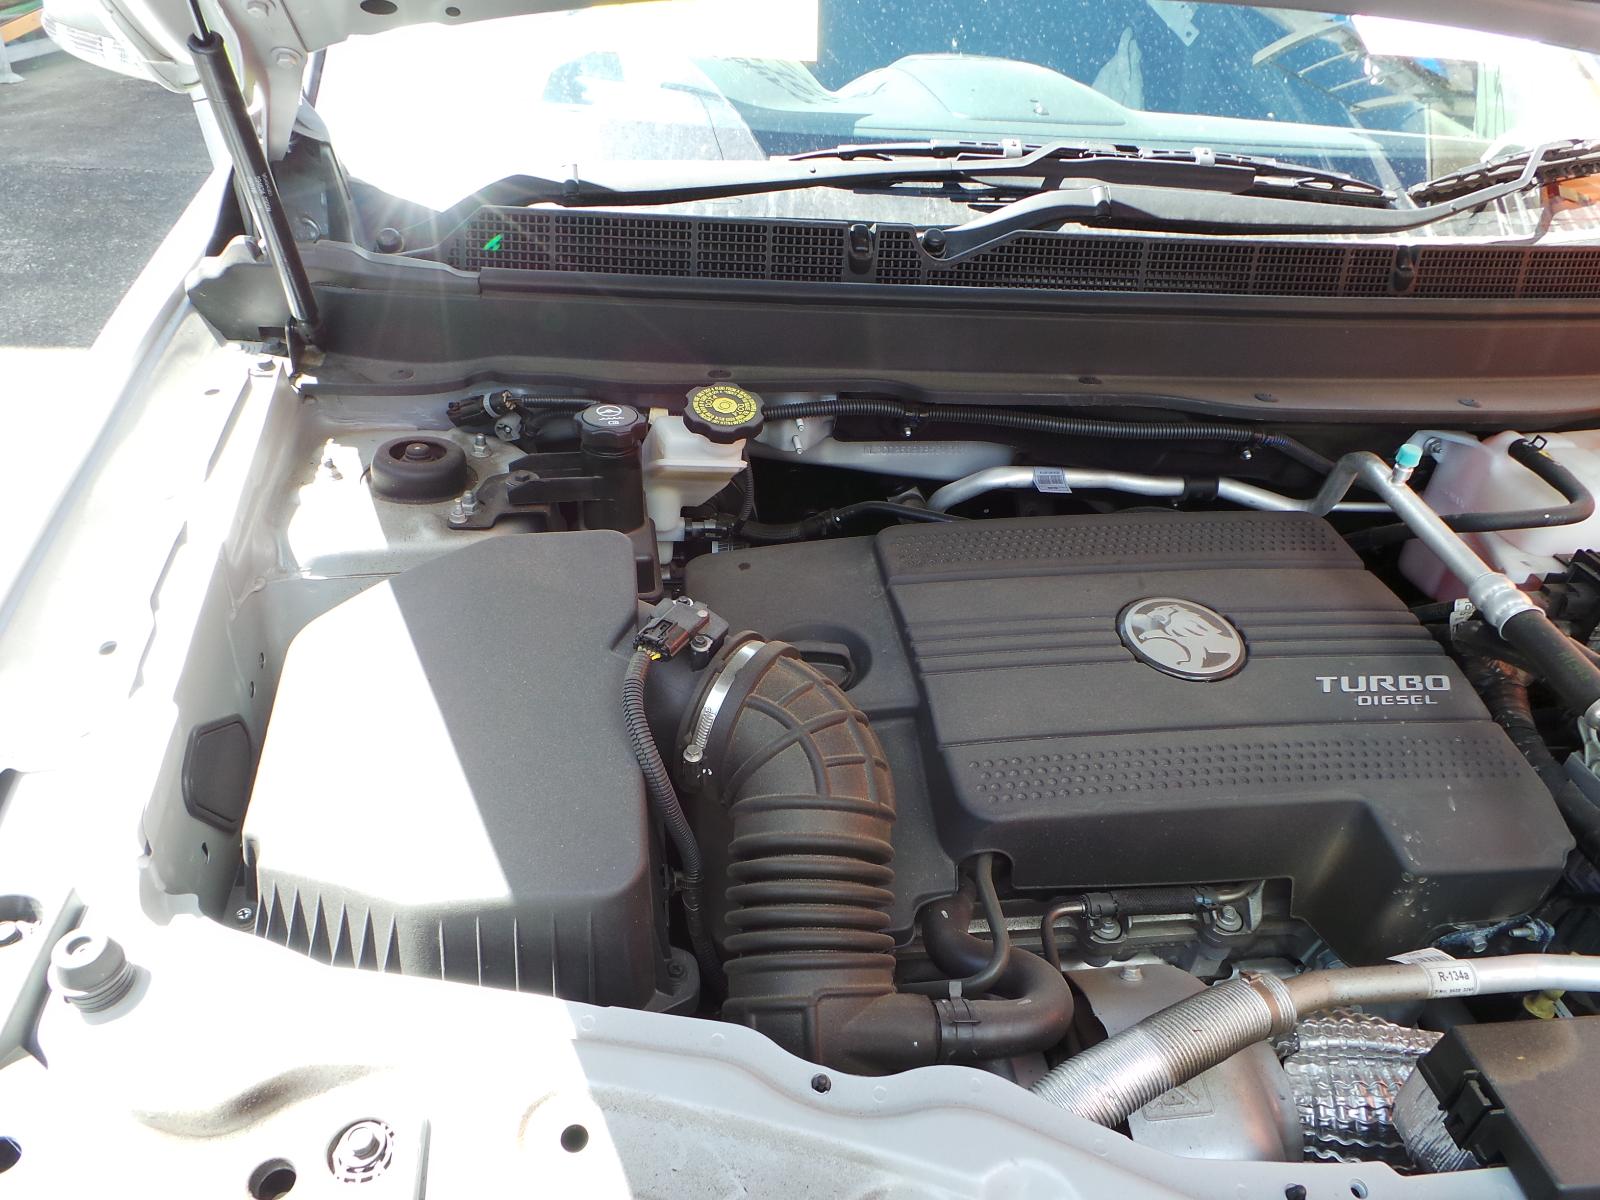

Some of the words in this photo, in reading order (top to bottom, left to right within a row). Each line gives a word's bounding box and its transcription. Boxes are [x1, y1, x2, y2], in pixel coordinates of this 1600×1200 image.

[1315, 674, 1451, 693] TURBO
[1357, 695, 1438, 706] DIESEL
[1437, 970, 1470, 982] R-134a
